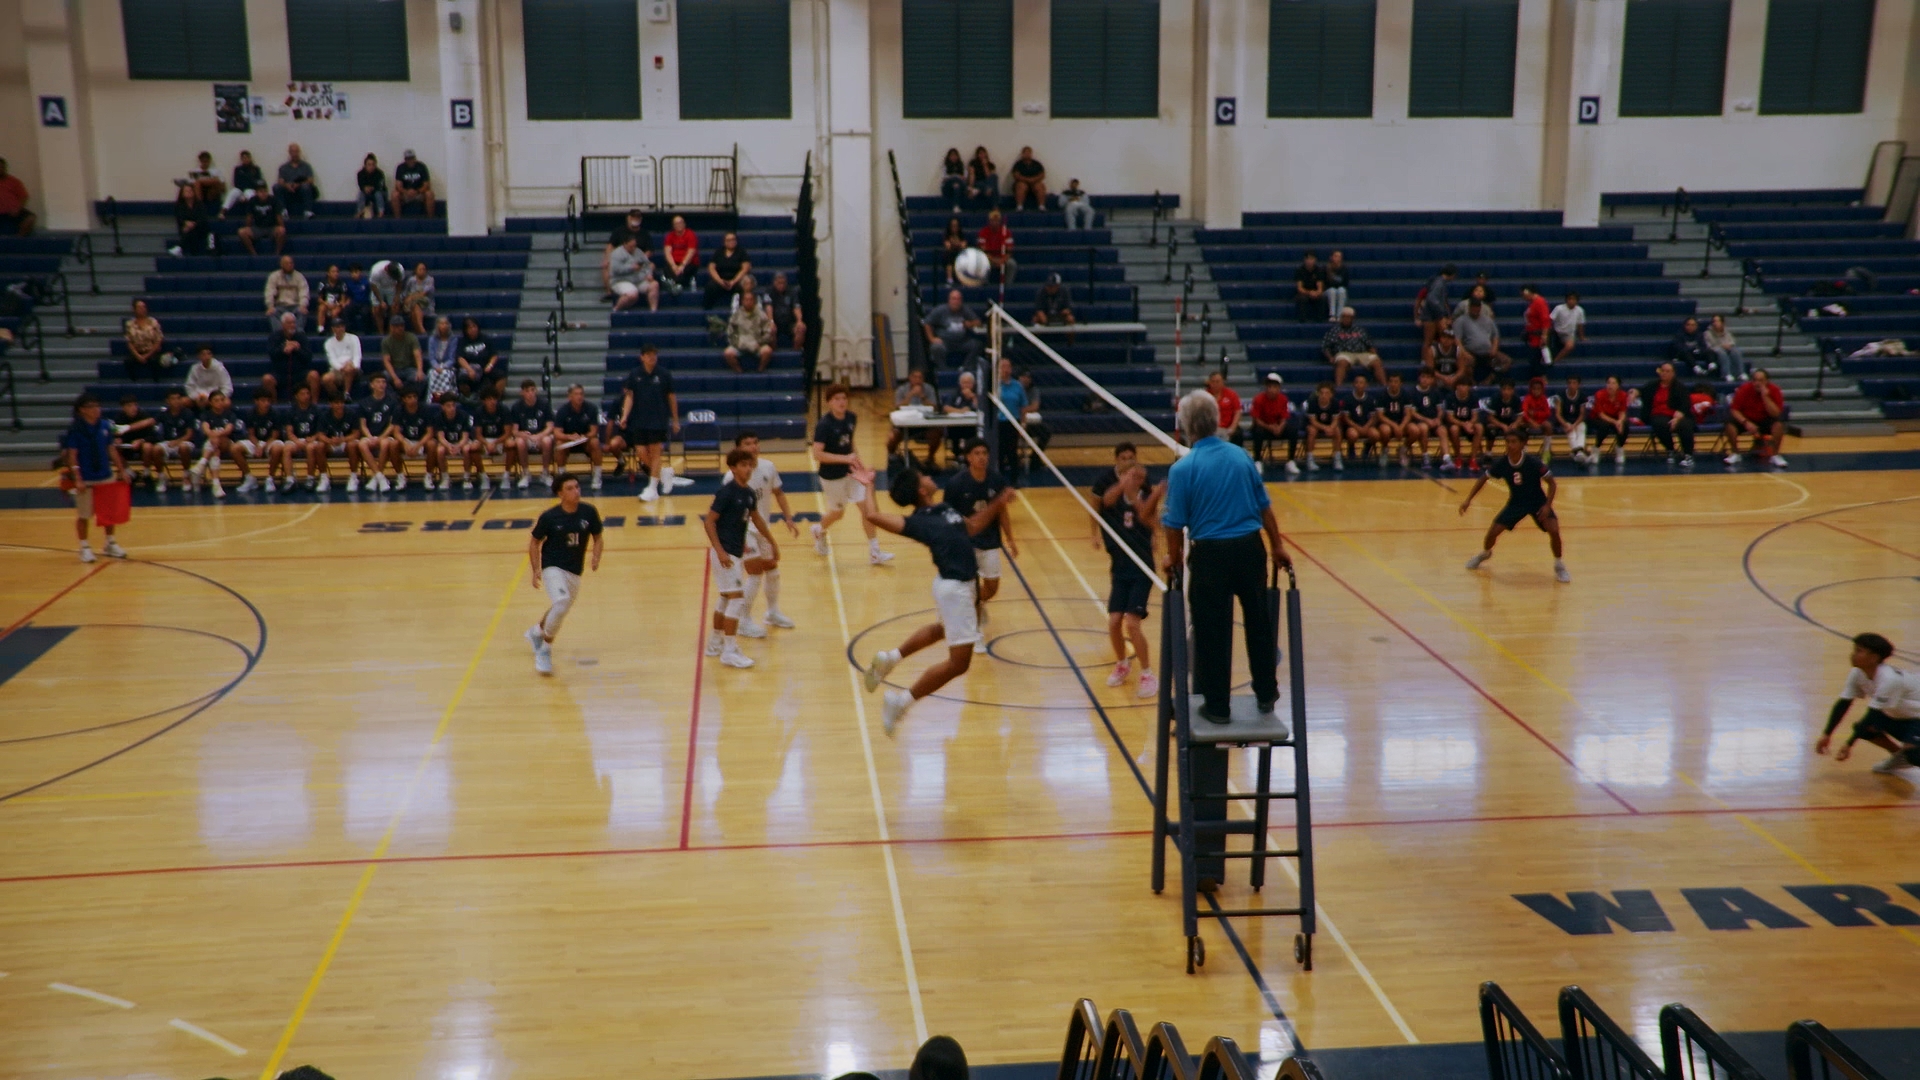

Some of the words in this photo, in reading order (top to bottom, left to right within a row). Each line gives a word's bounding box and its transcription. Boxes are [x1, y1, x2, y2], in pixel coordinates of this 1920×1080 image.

[45, 101, 65, 121] A
[455, 104, 472, 124] B
[1218, 101, 1233, 121] C
[1581, 101, 1597, 119] D
[1513, 471, 1522, 485] 2
[567, 532, 580, 547] 31
[1510, 883, 1920, 935] WAR
